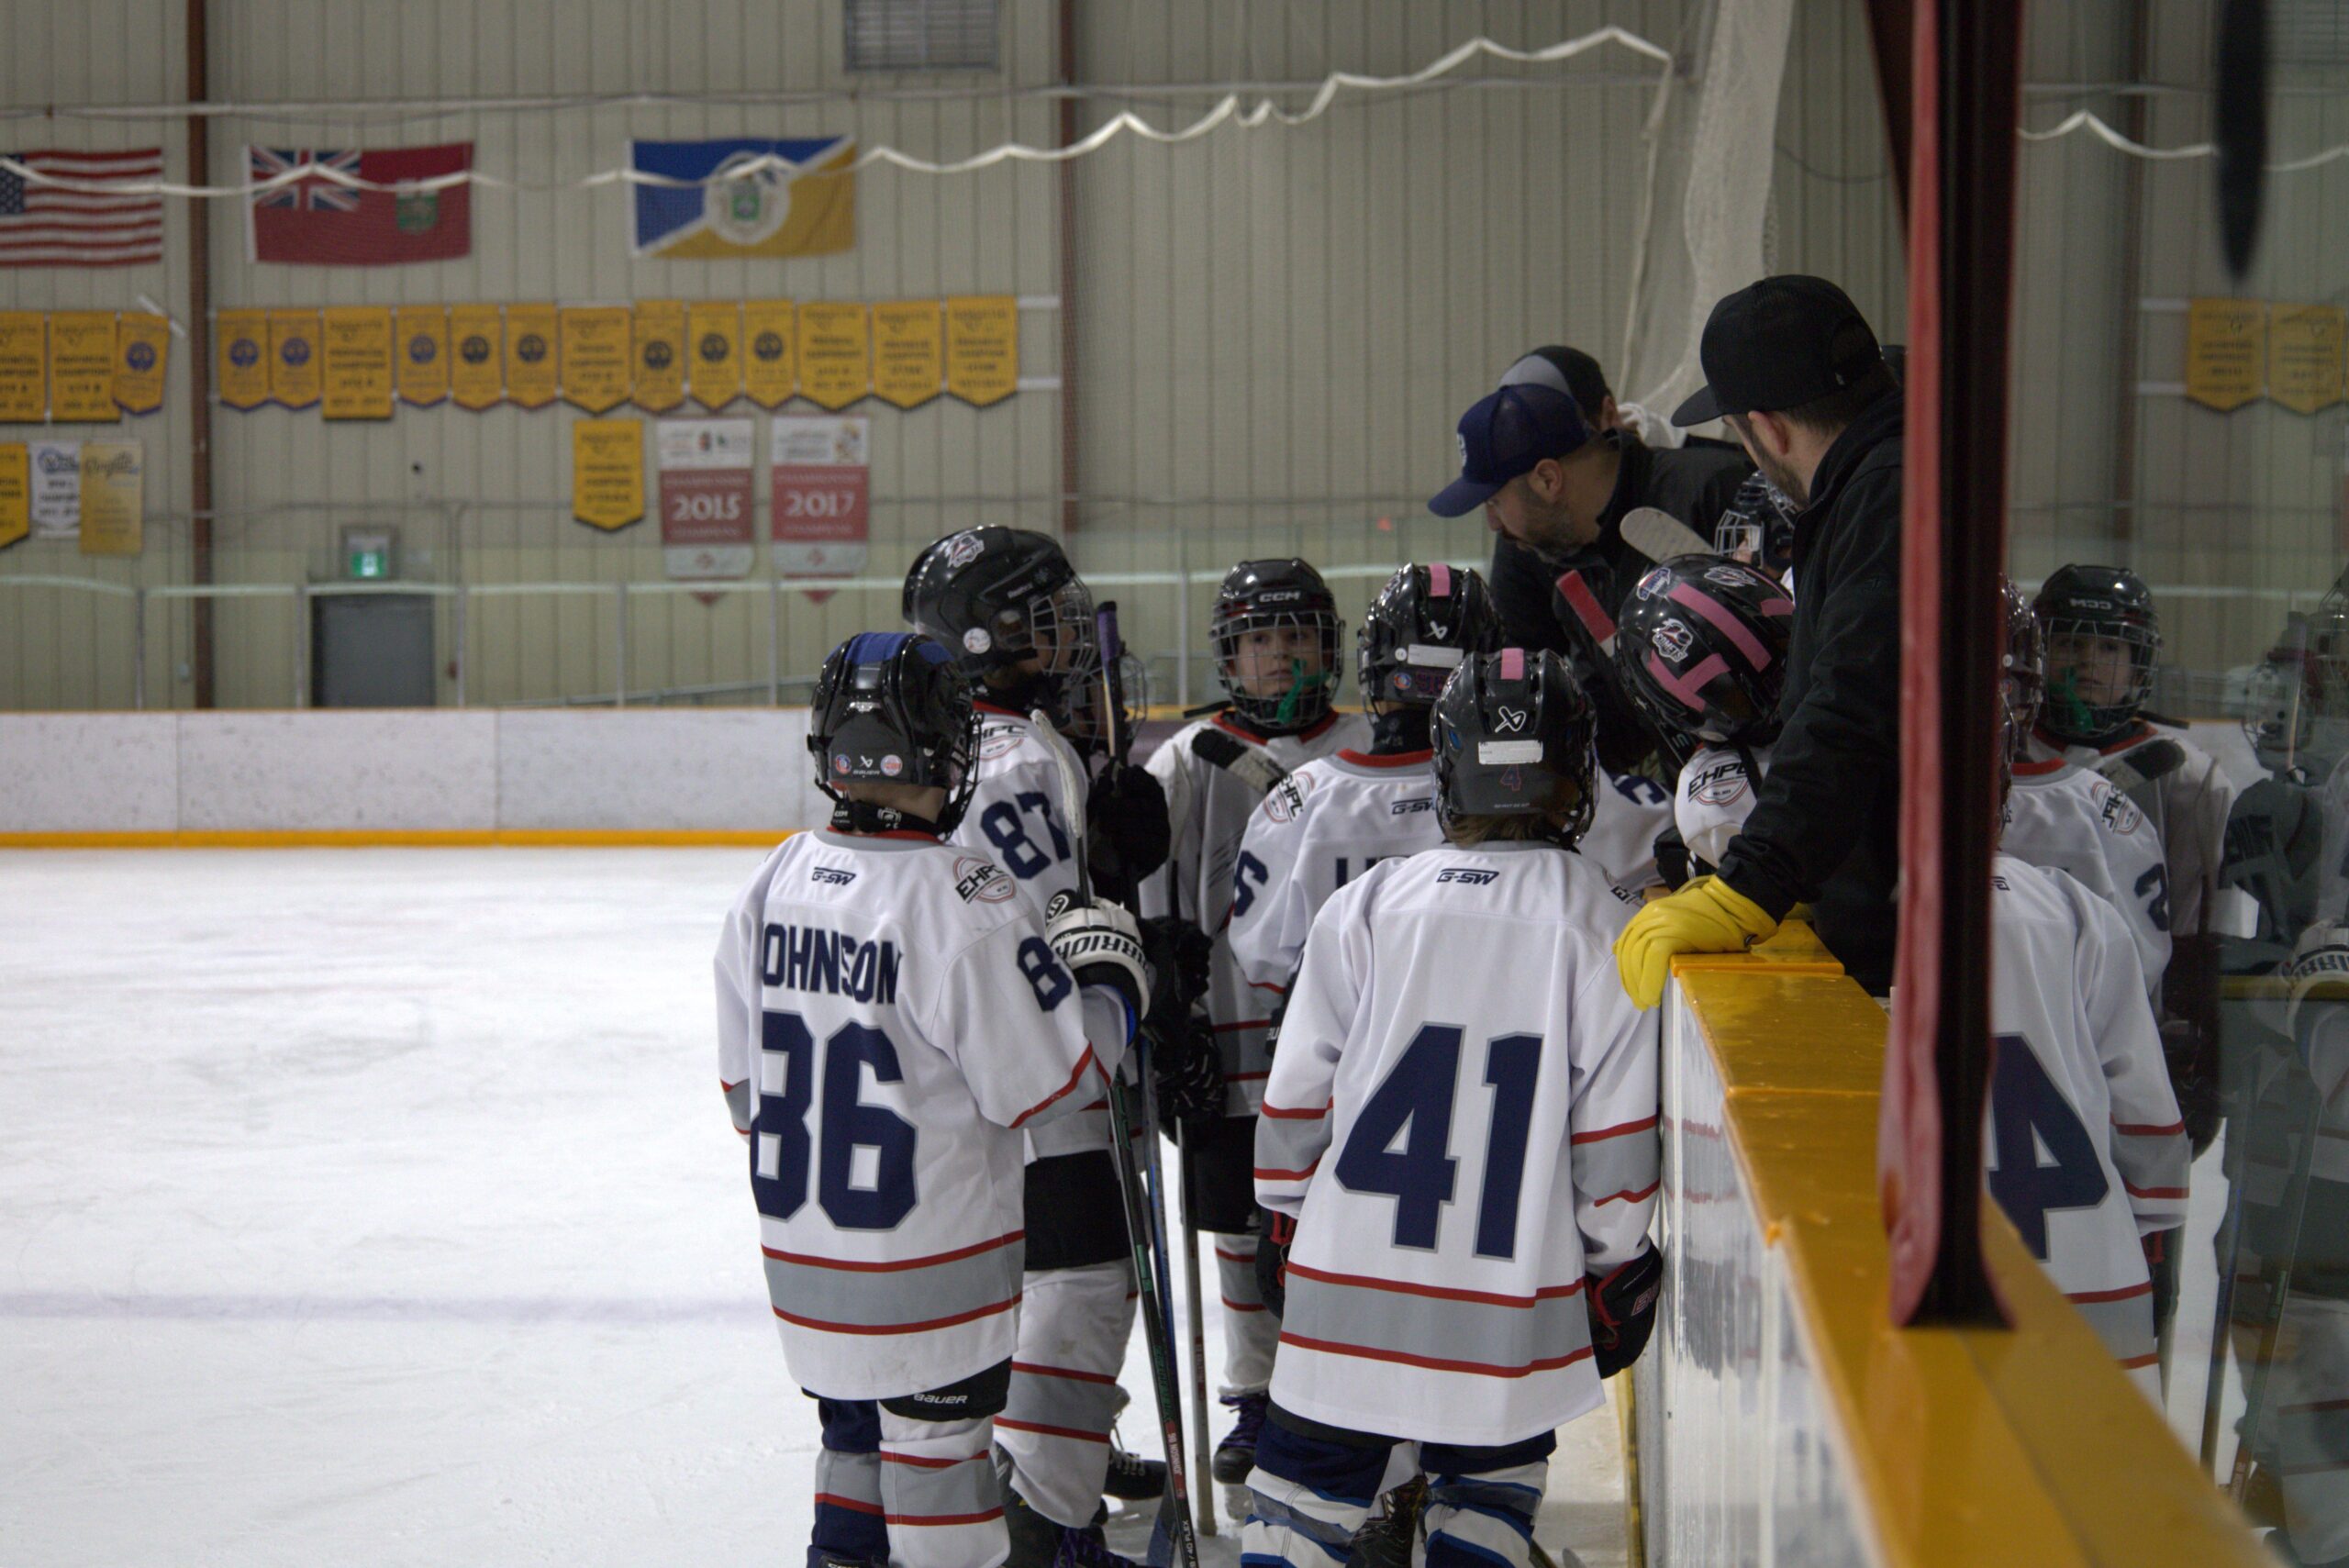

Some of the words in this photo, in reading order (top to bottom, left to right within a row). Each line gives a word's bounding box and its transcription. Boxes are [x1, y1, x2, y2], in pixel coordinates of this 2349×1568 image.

[672, 492, 742, 521] 2015
[784, 490, 855, 518] 2017
[1259, 591, 1300, 603] CCM
[980, 791, 1072, 879] 87
[811, 866, 856, 885] G-SW
[1436, 868, 1499, 885] G-SW
[763, 922, 904, 1005] OHNSON
[1055, 935, 1146, 970] ARRIOR
[1016, 935, 1073, 1012] 8
[750, 1007, 920, 1232] 86
[1333, 1020, 1545, 1263] 41
[913, 1393, 968, 1405] BAUER
[1169, 1443, 1180, 1475] JOHNSON
[1182, 1519, 1192, 1541] FLEX
